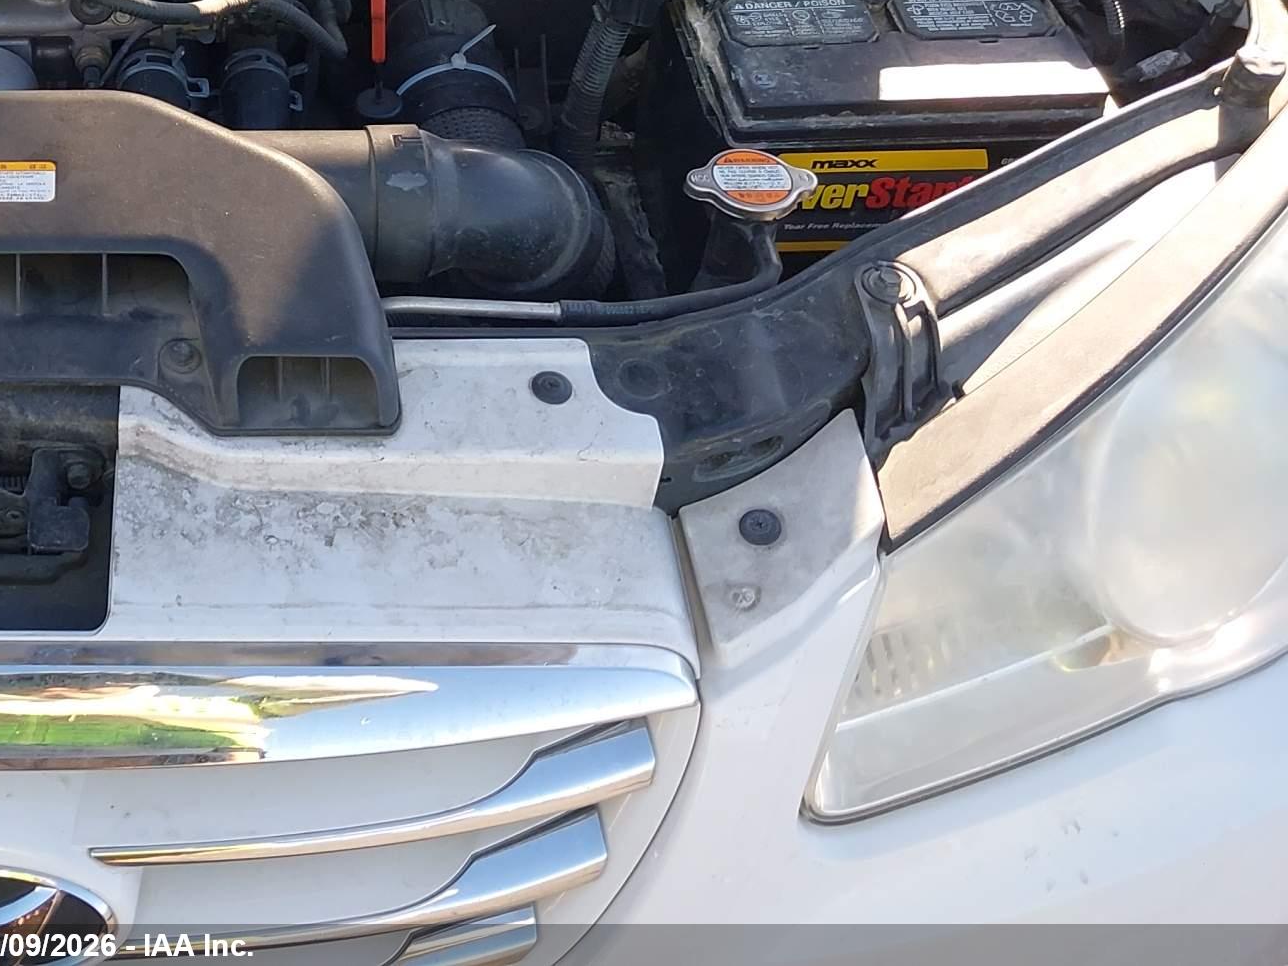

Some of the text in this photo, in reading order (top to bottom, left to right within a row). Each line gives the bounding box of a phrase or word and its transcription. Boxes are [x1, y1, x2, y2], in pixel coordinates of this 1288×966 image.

[744, 1, 793, 10] DANGER
[803, 0, 846, 7] POISON
[811, 158, 879, 169] maxx
